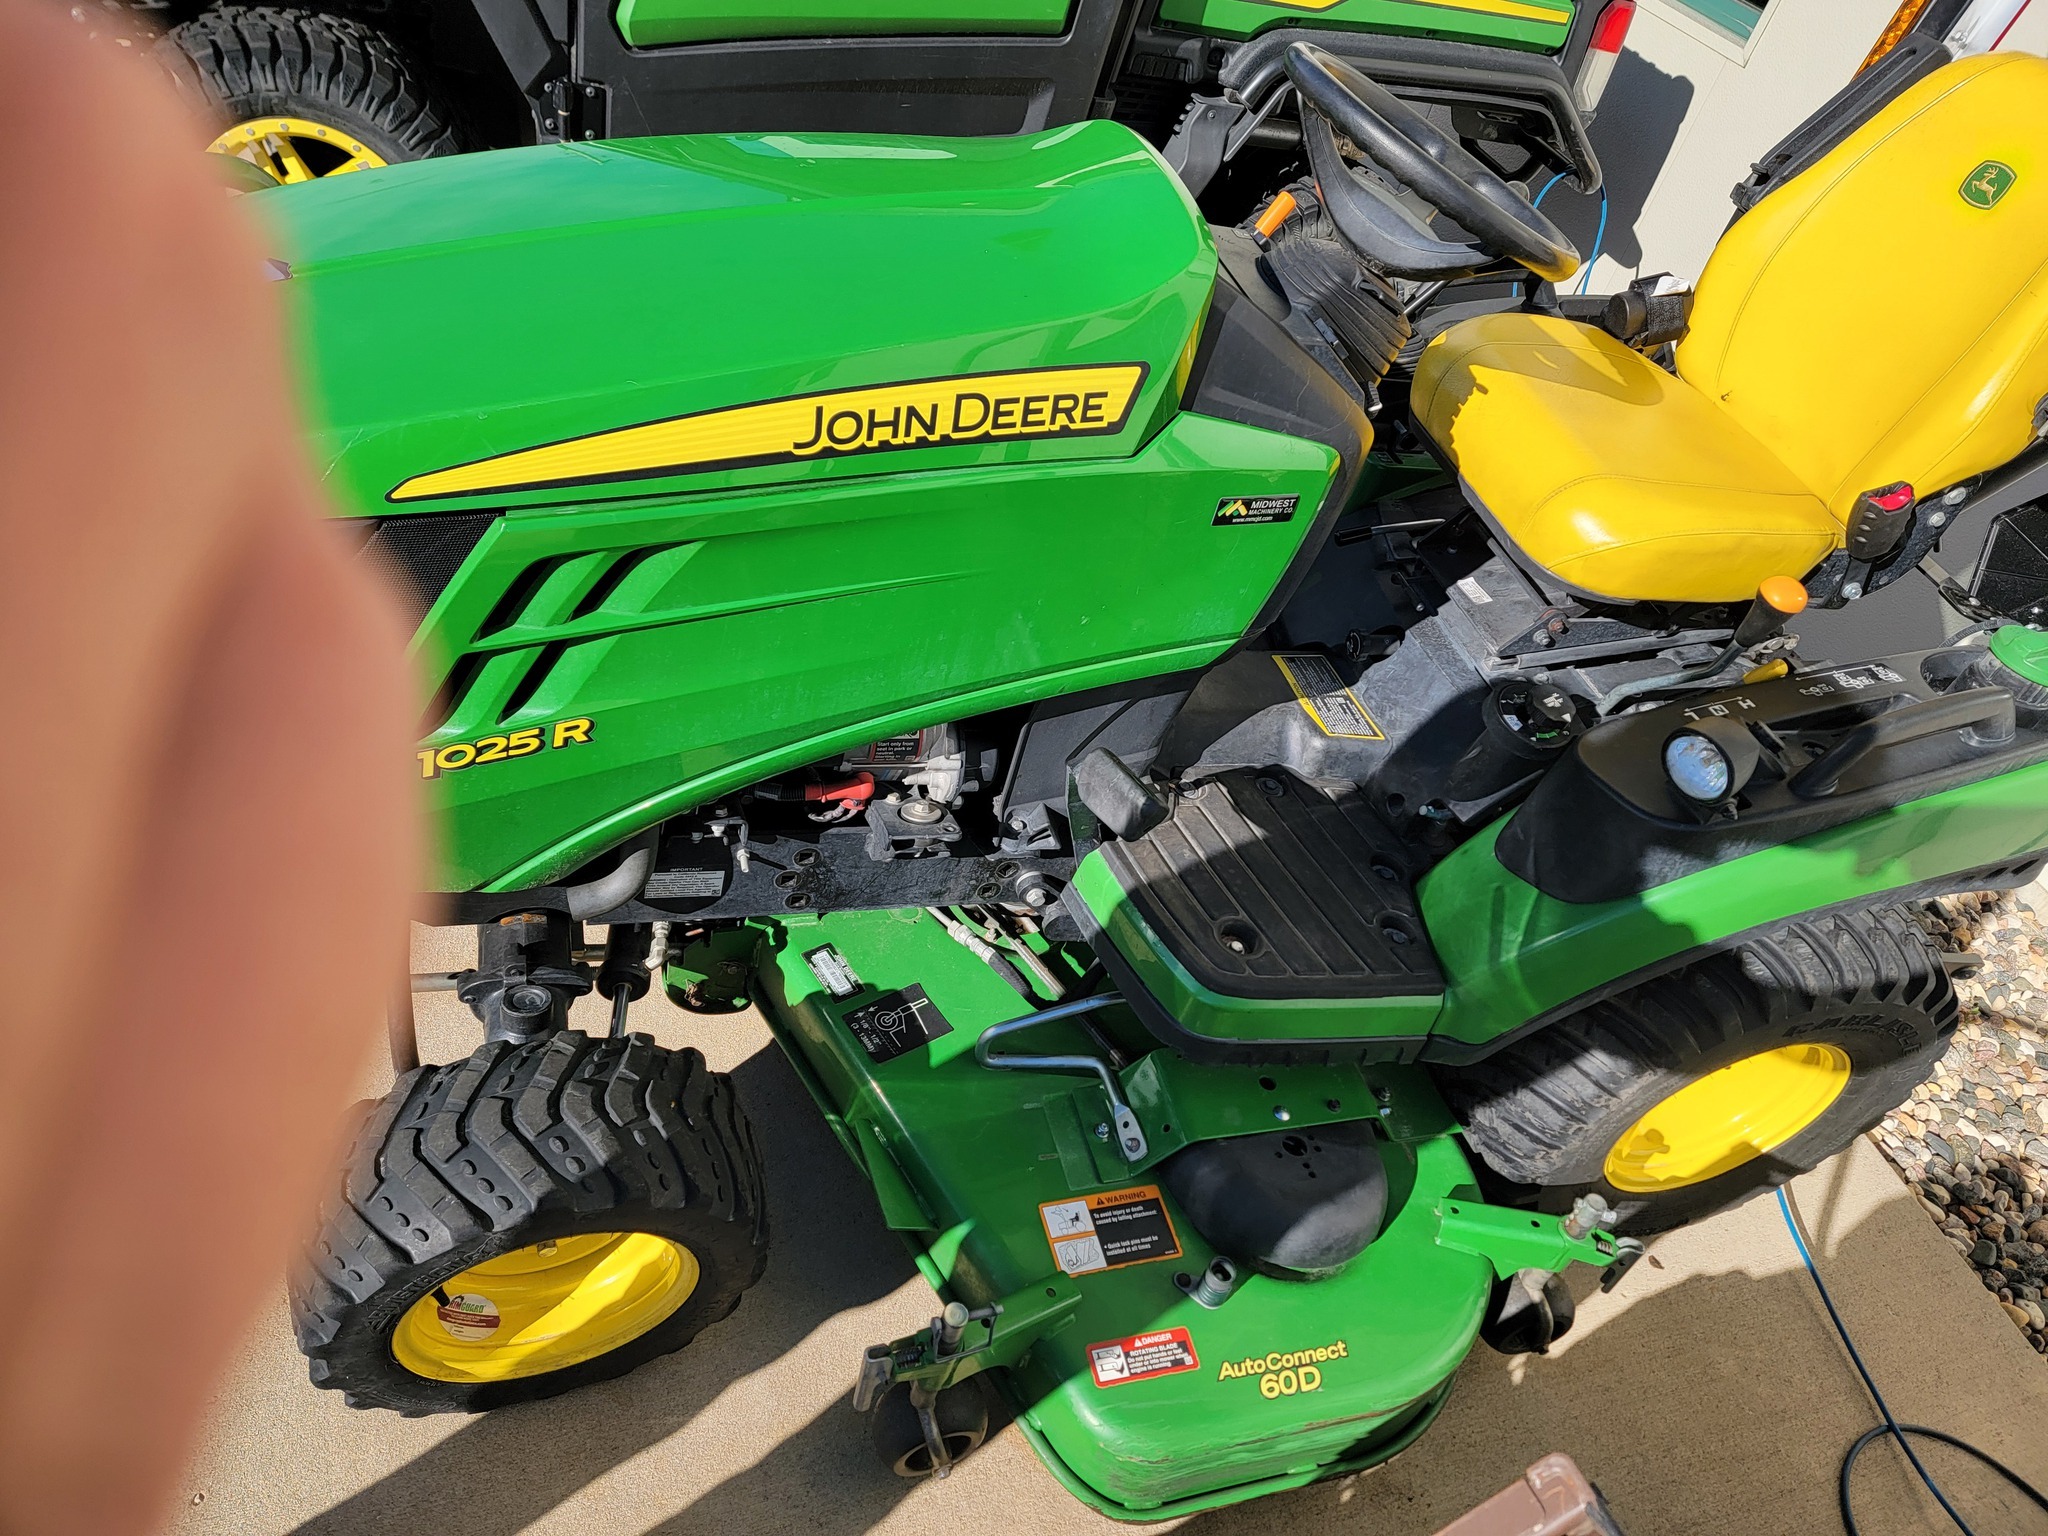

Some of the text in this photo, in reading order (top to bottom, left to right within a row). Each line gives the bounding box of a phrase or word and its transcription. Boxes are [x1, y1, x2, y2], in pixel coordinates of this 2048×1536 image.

[792, 391, 1109, 452] JOHN DEERE
[1250, 499, 1296, 509] MIDWEST
[416, 718, 597, 781] 1025 R
[1105, 1191, 1147, 1204] WARNING
[1141, 1333, 1172, 1345] DANGER
[1129, 1347, 1158, 1357] ROTATING
[1217, 1338, 1349, 1382] AutoConnect
[1259, 1365, 1322, 1400] 60D
